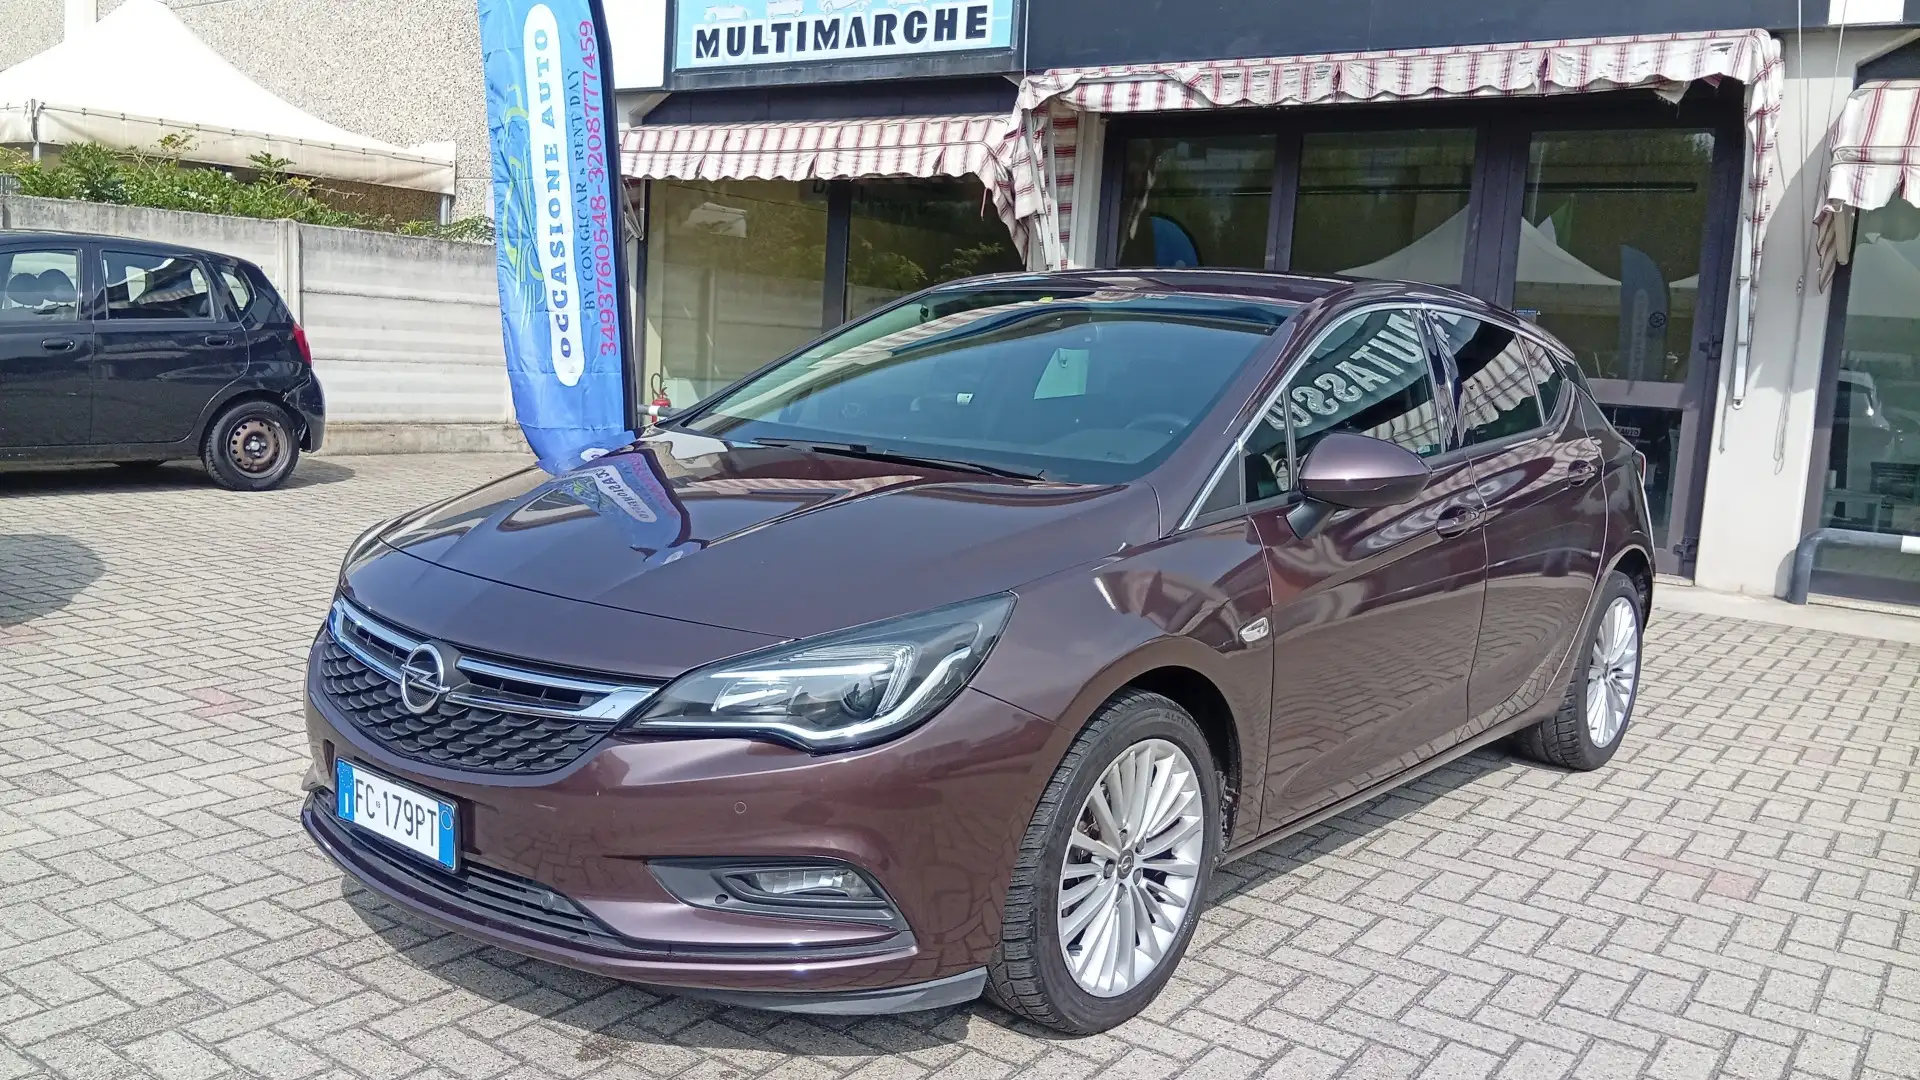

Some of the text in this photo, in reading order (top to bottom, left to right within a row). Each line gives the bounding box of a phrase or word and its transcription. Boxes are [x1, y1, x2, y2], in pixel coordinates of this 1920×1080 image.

[695, 5, 988, 59] MULTIMARCHE
[567, 69, 581, 107] DAY
[570, 114, 584, 161] RENT
[534, 29, 572, 358] OCCASIONE AUTO
[579, 20, 617, 357] 3493760548-3208777459
[584, 289, 596, 311] BY
